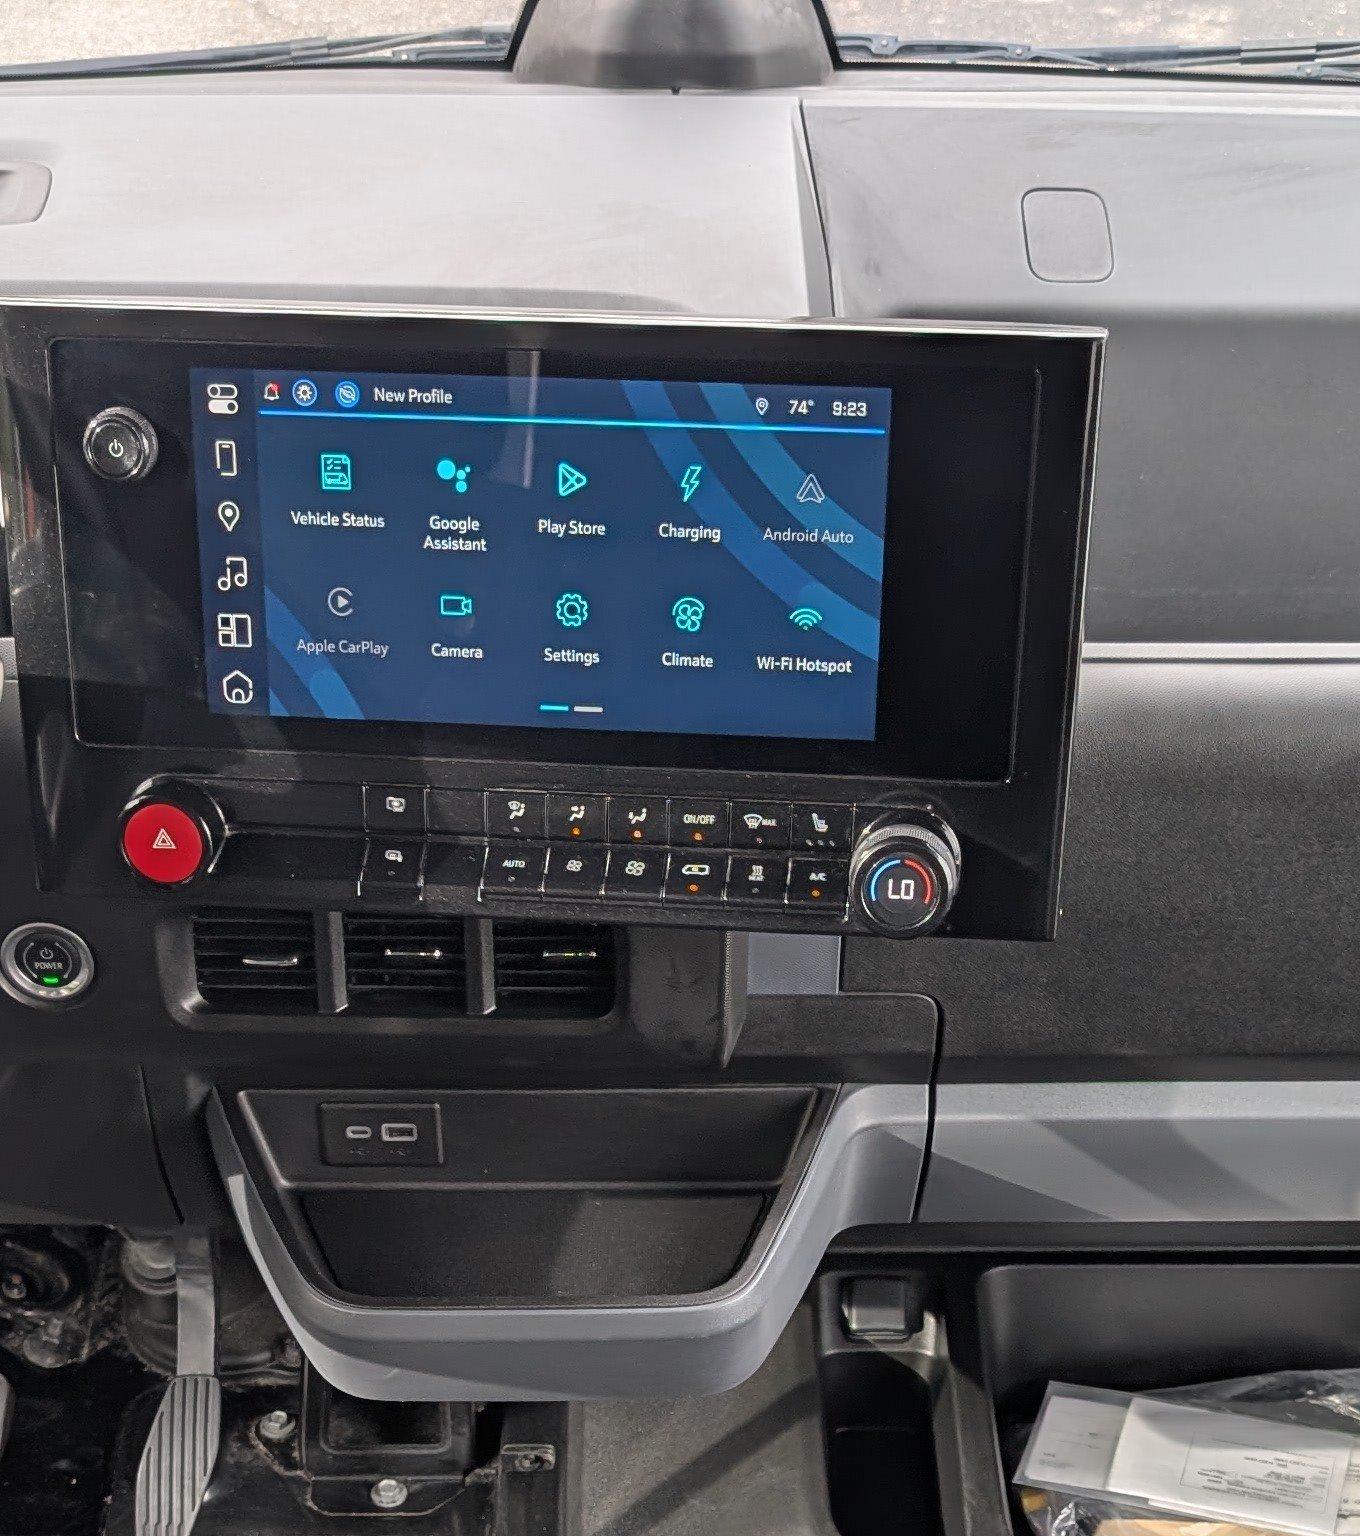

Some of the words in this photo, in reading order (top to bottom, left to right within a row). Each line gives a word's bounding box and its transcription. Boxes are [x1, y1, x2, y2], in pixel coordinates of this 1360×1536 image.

[374, 386, 405, 403] New
[408, 388, 453, 404] Profile
[832, 401, 868, 417] 9:23
[290, 510, 340, 527] Vehicle
[341, 512, 386, 528] Status
[429, 515, 480, 534] Google
[538, 518, 566, 538] Play
[567, 520, 607, 536] Store
[658, 523, 722, 543] Charging
[763, 527, 818, 542] Android
[820, 529, 855, 544] Auto
[423, 534, 488, 552] Assistant
[297, 639, 336, 655] Apple
[339, 640, 389, 658] CarPlay
[431, 643, 483, 659] Camera
[543, 648, 600, 666] Settings
[662, 652, 714, 668] Climate
[756, 656, 792, 670] Wi-Fi
[796, 658, 853, 675] Hotspot
[683, 813, 716, 825] ON/OFF
[761, 818, 777, 827] MAX
[502, 859, 526, 868] AUTO
[809, 872, 828, 882] A/C
[887, 878, 915, 900] LO
[33, 961, 63, 970] POWER
